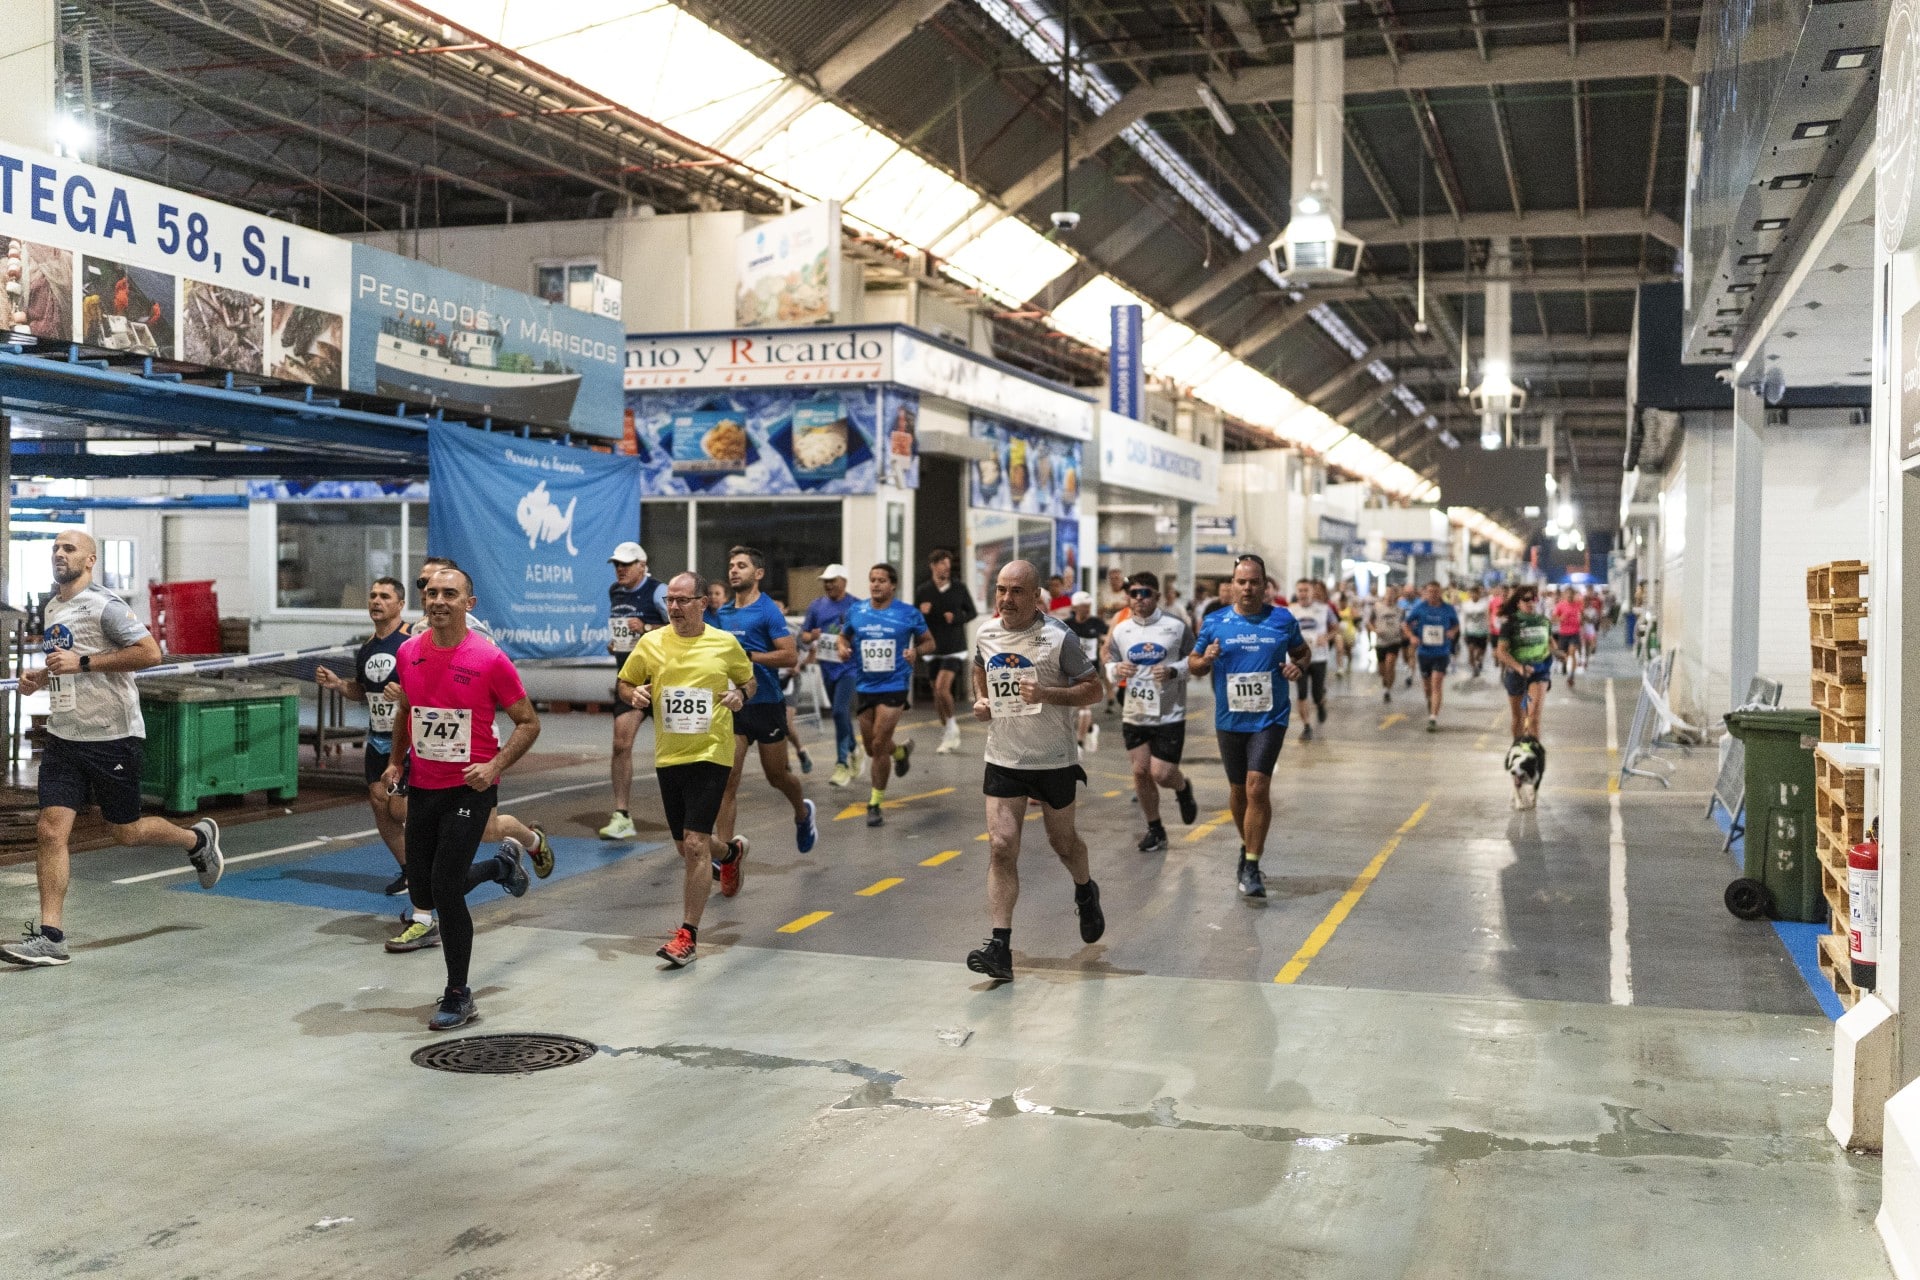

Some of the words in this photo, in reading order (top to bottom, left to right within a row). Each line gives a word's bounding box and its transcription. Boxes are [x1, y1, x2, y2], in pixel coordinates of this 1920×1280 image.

[157, 202, 222, 274] 58,
[242, 225, 310, 289] S.L.
[603, 298, 619, 316] 58
[358, 273, 490, 331] PESCADOS
[499, 316, 511, 335] Y
[519, 319, 618, 364] MARISCOS
[693, 345, 715, 373] y
[730, 331, 883, 364] Ricardo
[525, 563, 574, 584] AEMPM
[863, 647, 892, 659] 1030
[1131, 686, 1154, 701] 643
[1235, 682, 1263, 697] 1113
[371, 703, 394, 717] 467
[664, 698, 707, 715] 1285
[421, 720, 460, 740] 747
